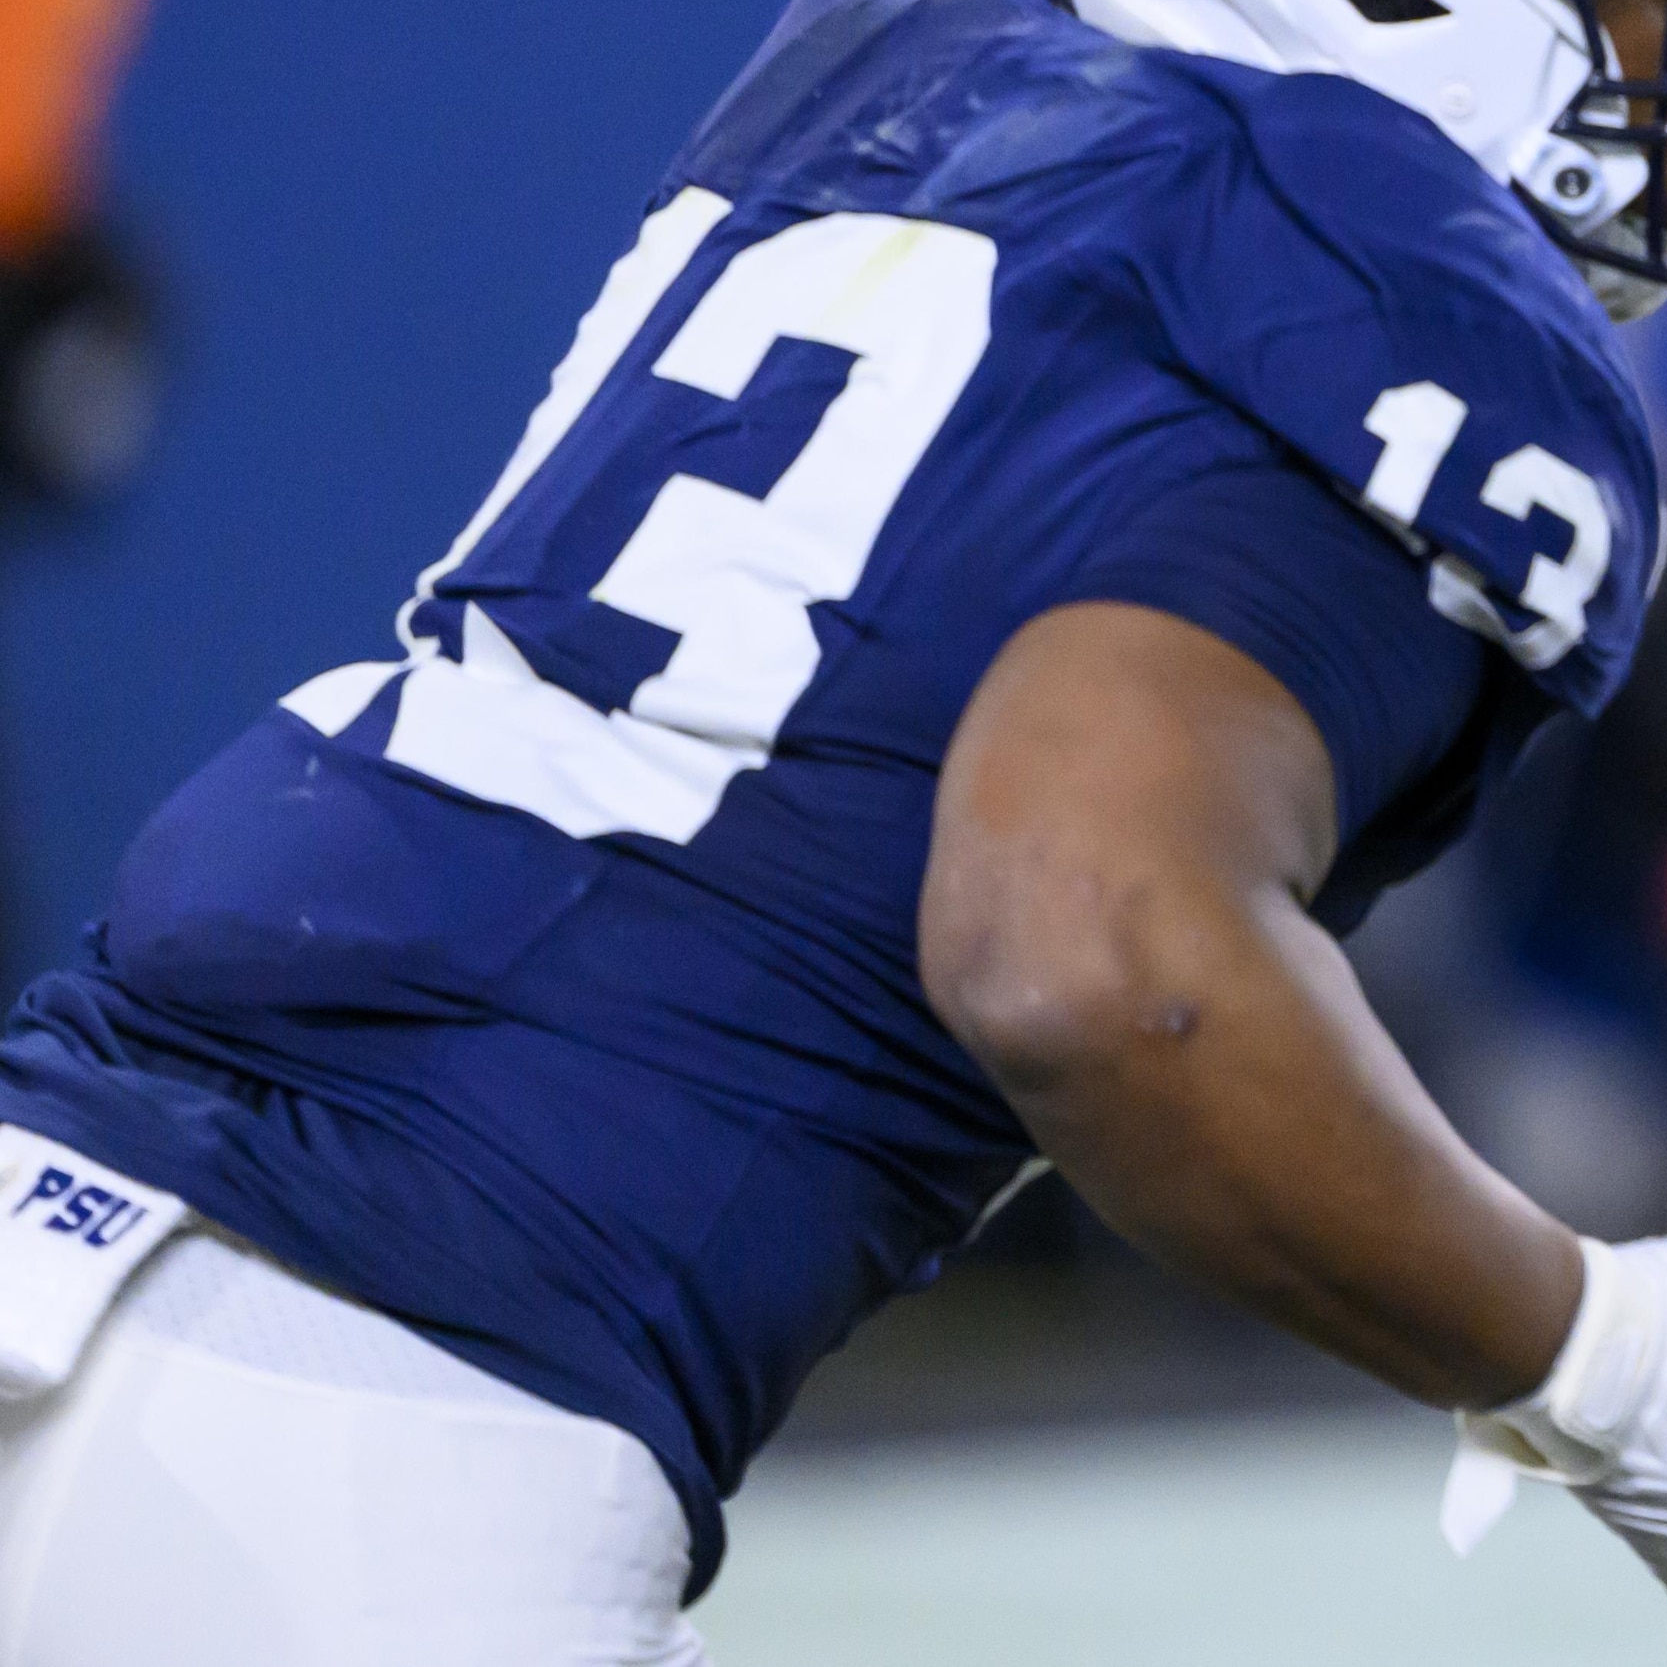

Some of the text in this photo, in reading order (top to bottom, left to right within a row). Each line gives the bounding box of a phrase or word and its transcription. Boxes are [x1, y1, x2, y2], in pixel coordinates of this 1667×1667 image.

[279, 187, 998, 846] 13
[1363, 379, 1612, 671] 13
[11, 1165, 149, 1248] PSU
